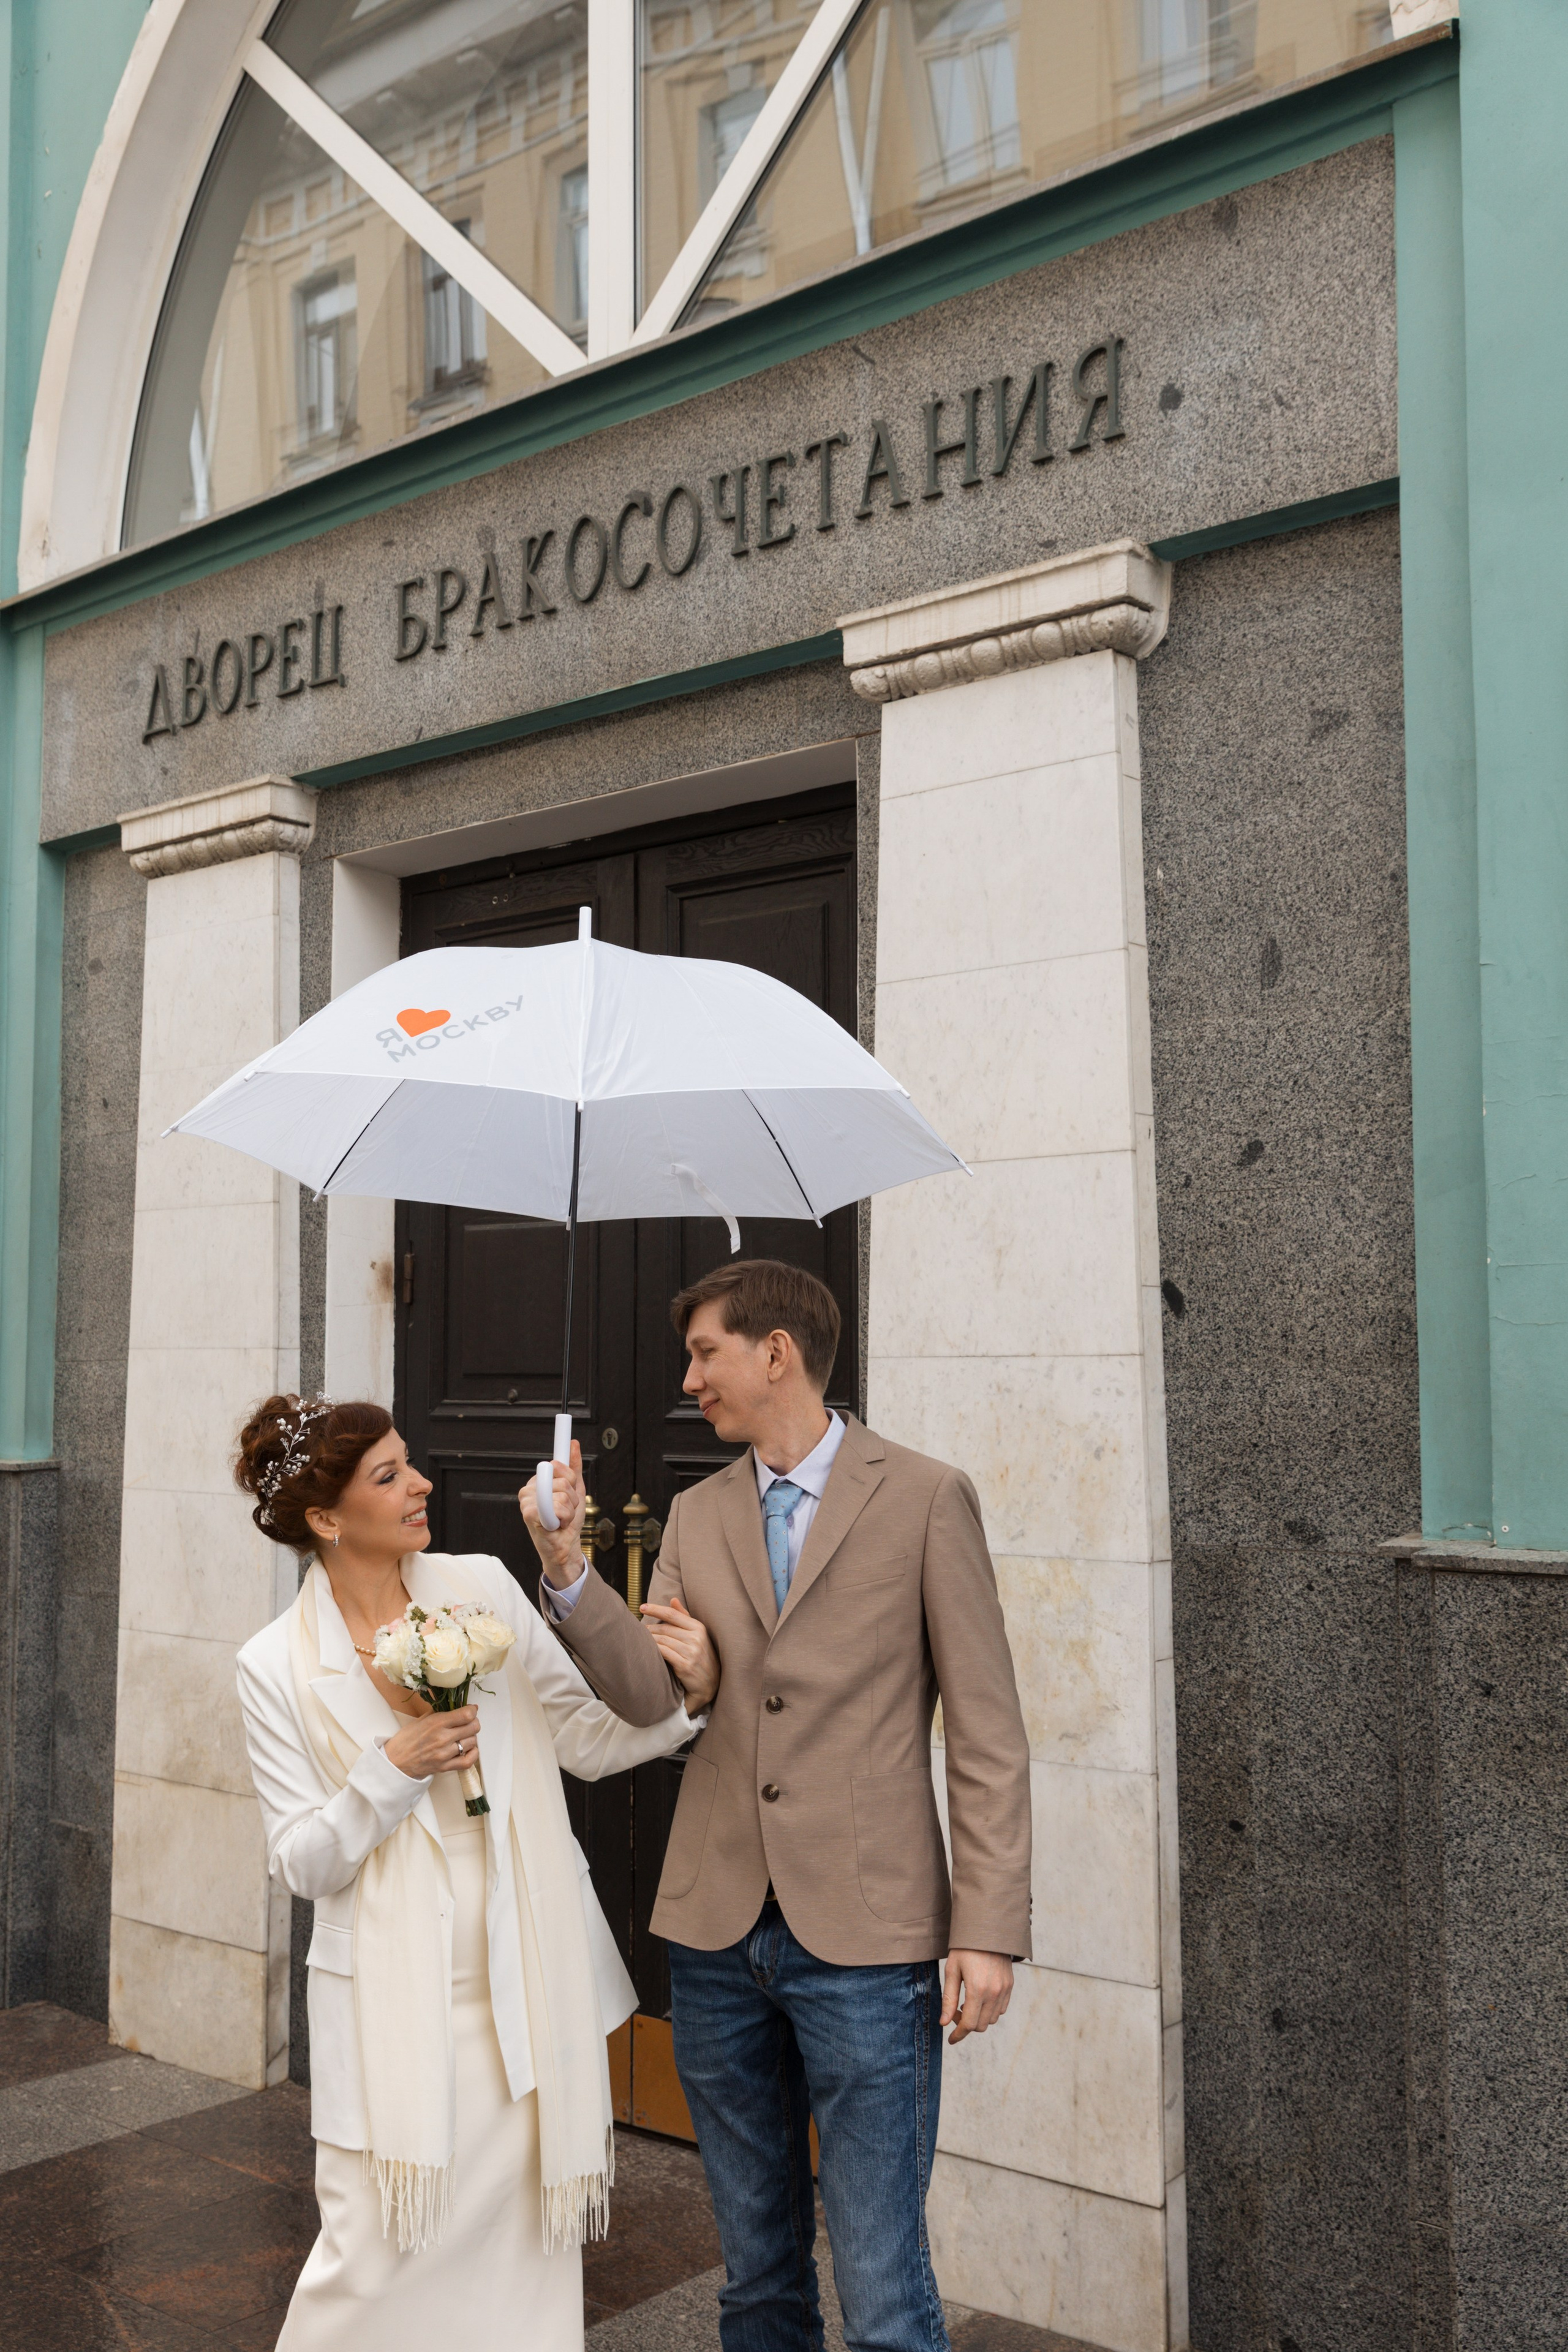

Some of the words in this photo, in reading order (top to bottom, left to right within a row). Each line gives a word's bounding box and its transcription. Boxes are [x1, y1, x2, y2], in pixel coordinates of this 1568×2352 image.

[143, 603, 345, 745] ДВОРЕЦ
[394, 334, 1125, 662] БРАКОСОЧЕТАНИЯ
[375, 1028, 404, 1048] Я
[387, 995, 524, 1063] МОСКВУ
